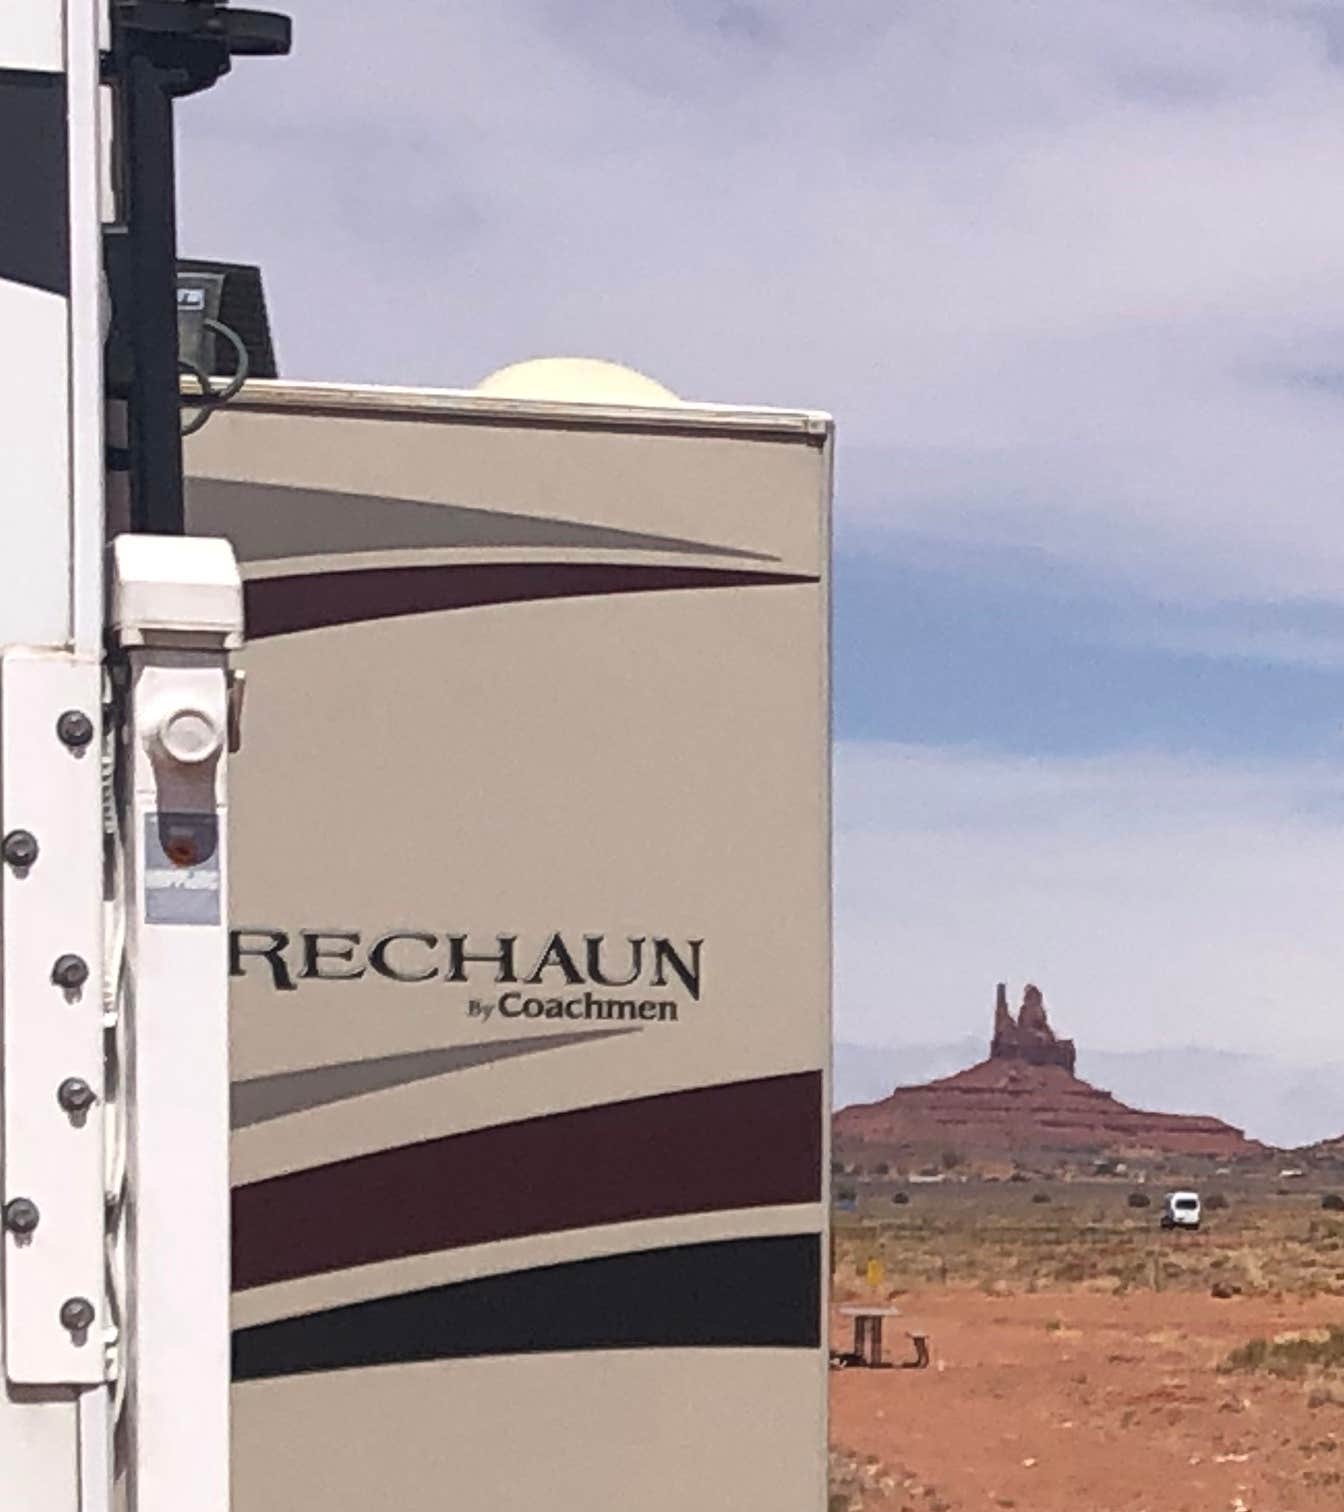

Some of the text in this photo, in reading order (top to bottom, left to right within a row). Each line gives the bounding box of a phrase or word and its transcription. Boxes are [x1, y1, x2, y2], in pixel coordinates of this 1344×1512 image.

[230, 929, 704, 1001] RECHAUN
[467, 991, 679, 1024] By Coachmen
